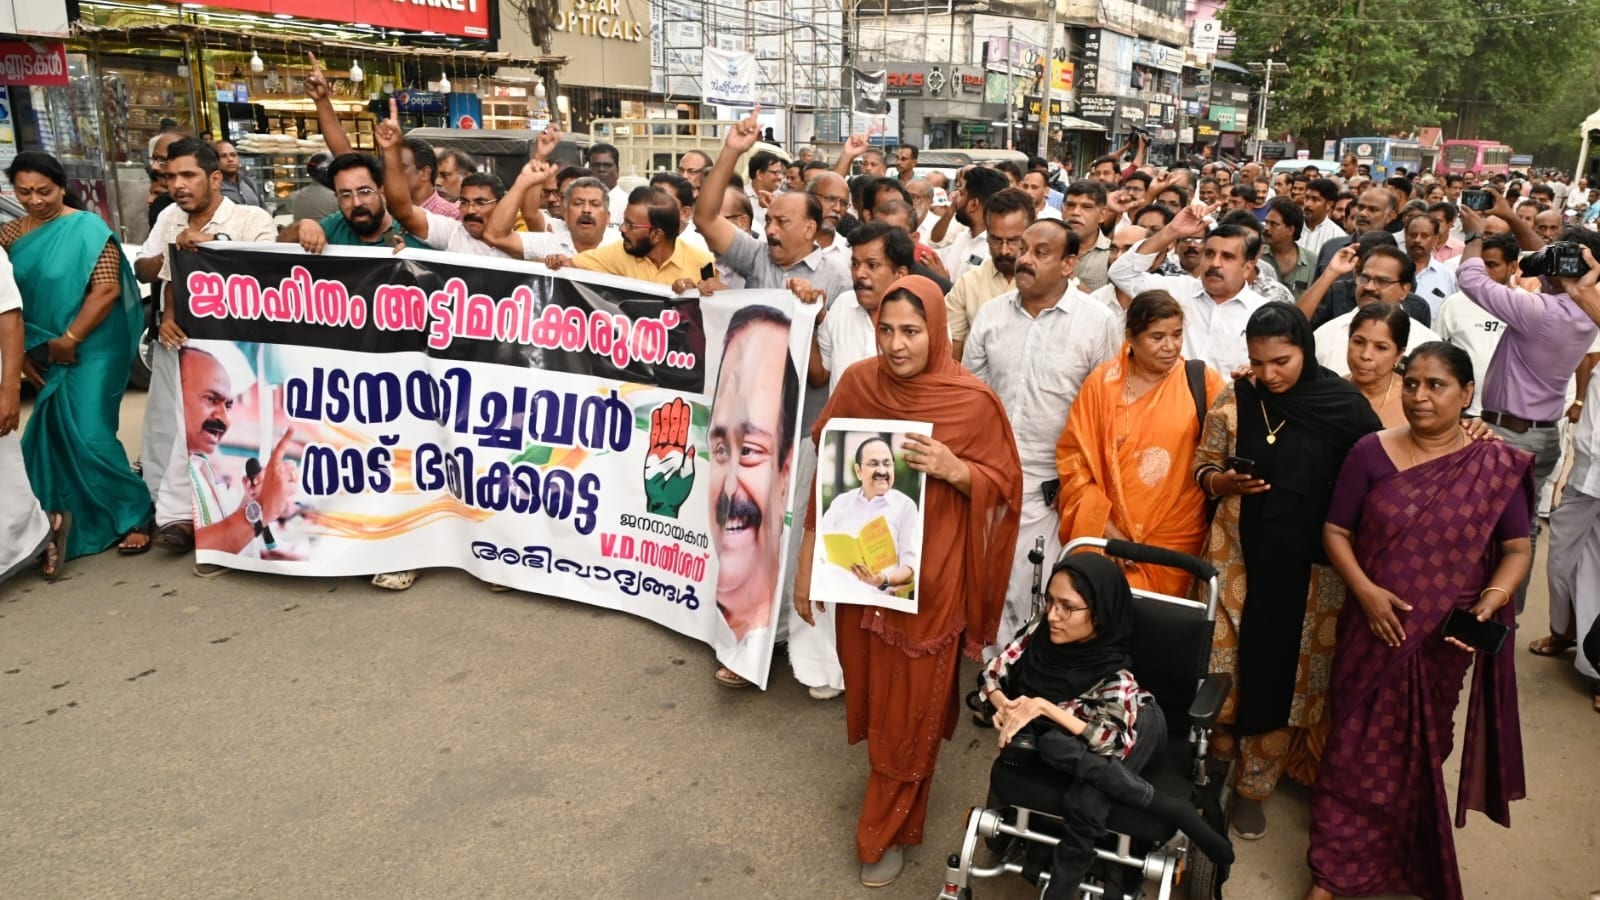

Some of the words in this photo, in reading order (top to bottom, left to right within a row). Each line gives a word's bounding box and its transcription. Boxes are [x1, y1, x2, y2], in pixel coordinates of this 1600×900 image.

[555, 9, 642, 42] OPTICALS
[887, 72, 924, 87] RKS
[410, 96, 432, 105] pepsi
[187, 265, 367, 329] ജനഹിതം
[373, 277, 696, 369] അട്ടിമറിക്കരുത്...
[1484, 321, 1499, 332] 97
[286, 367, 632, 451] പടനയിച്ചവൻ
[302, 434, 400, 496] നാട്
[415, 443, 601, 536] ഭരിക്കട്ടെ
[619, 513, 709, 549] ജനനായകൻ
[471, 541, 701, 610] അഭിവാദ്യങ്ങൾ
